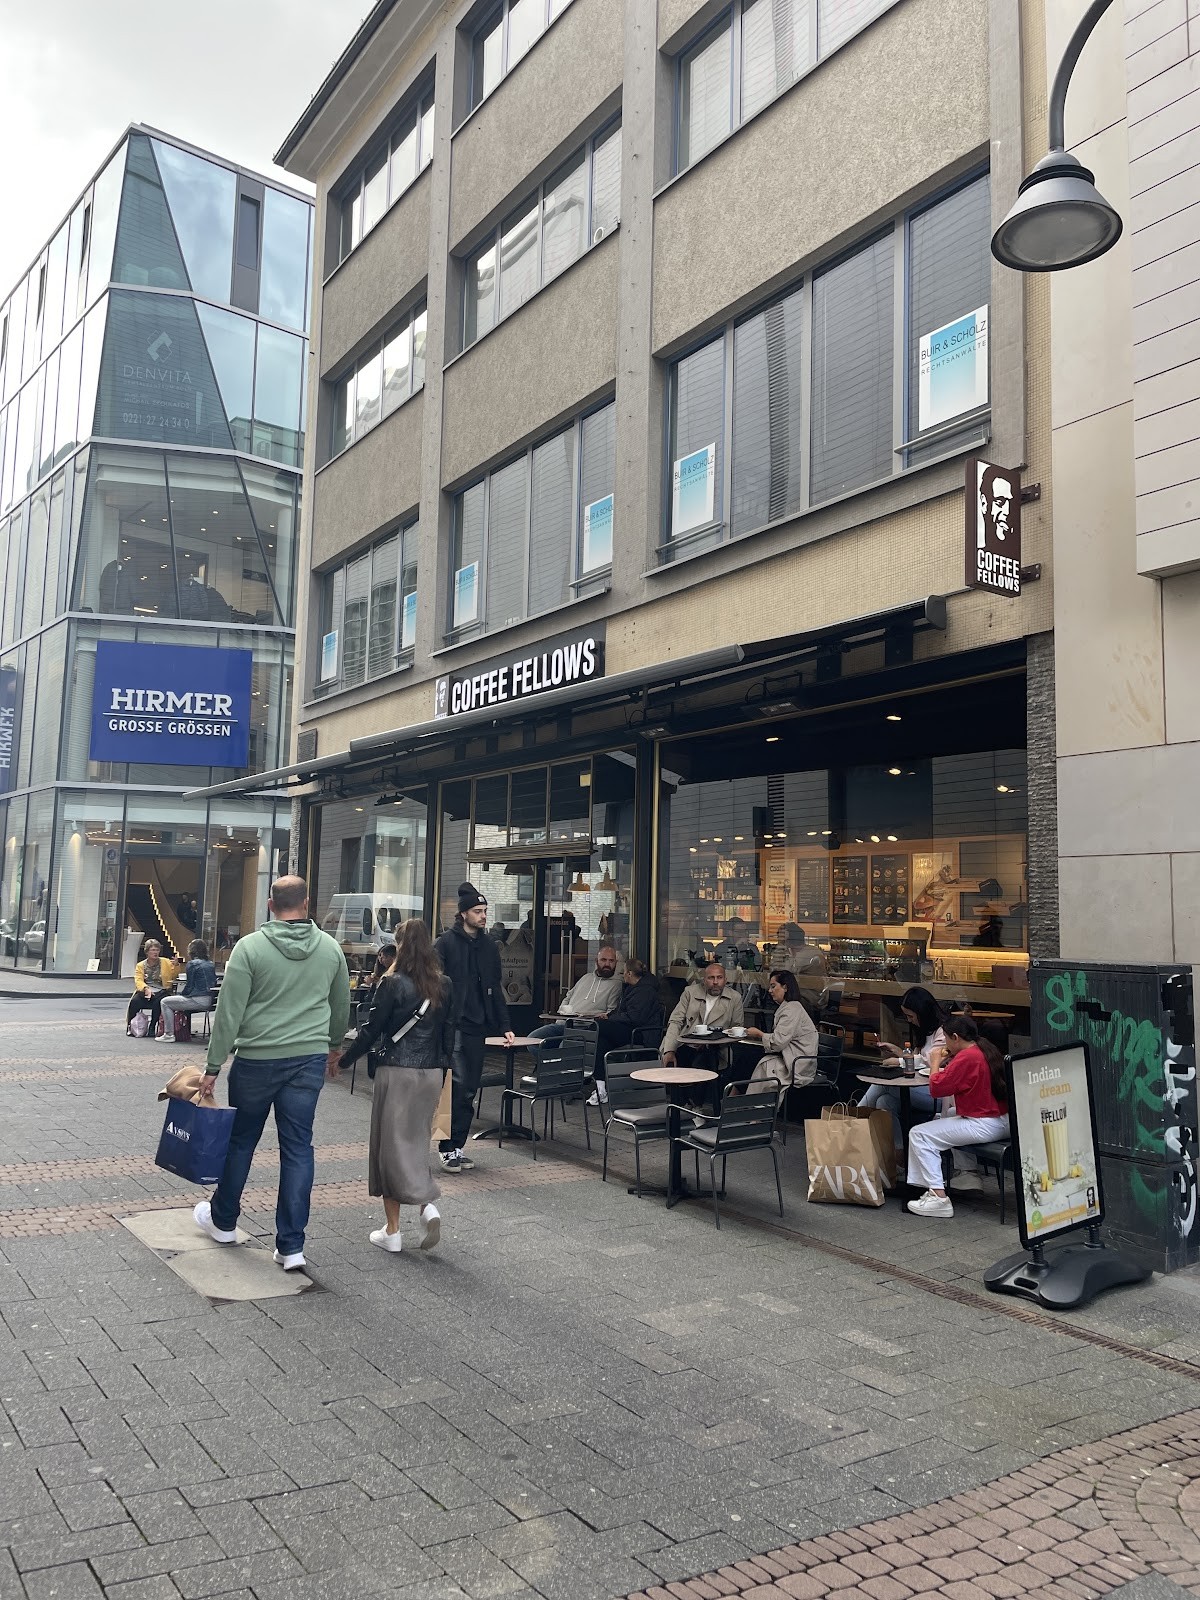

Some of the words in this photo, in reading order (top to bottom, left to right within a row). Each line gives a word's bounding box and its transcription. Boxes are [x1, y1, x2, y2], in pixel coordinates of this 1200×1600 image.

[921, 343, 941, 360] BUIR
[943, 339, 949, 350] &
[951, 320, 987, 346] SCHOLZ
[123, 364, 192, 384] DENVITA
[977, 549, 1020, 579] COFFEE
[977, 568, 1020, 592] FELLOWS
[451, 666, 508, 714] COFFEE
[512, 637, 596, 697] FELLOWS
[110, 687, 233, 717] HIRMER
[108, 718, 163, 733] GROSSE
[168, 720, 231, 737] GRÖSSEN
[1027, 1065, 1062, 1085] Indian
[1039, 1081, 1072, 1100] dream
